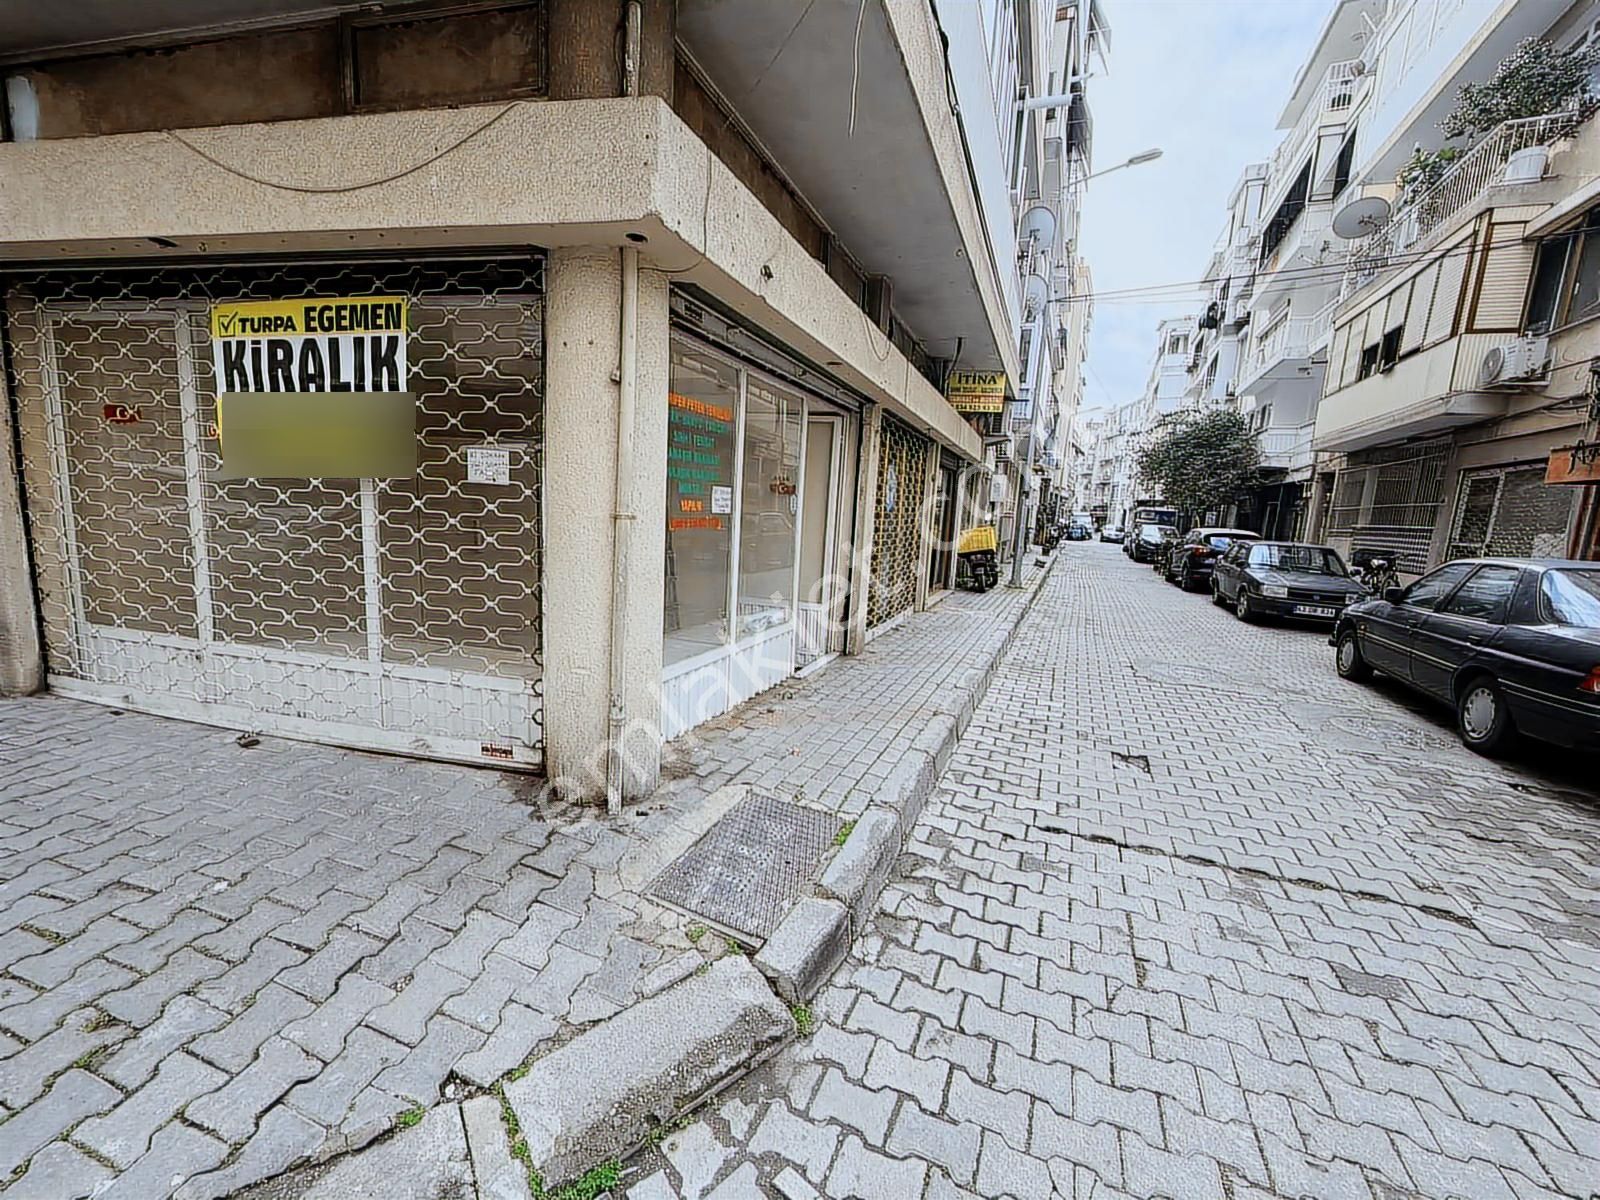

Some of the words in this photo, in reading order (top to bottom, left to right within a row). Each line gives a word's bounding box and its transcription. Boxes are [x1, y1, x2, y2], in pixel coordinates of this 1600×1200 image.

[238, 315, 298, 333] TURPA
[303, 303, 402, 332] EGEMEN
[222, 335, 400, 392] KİRALIK
